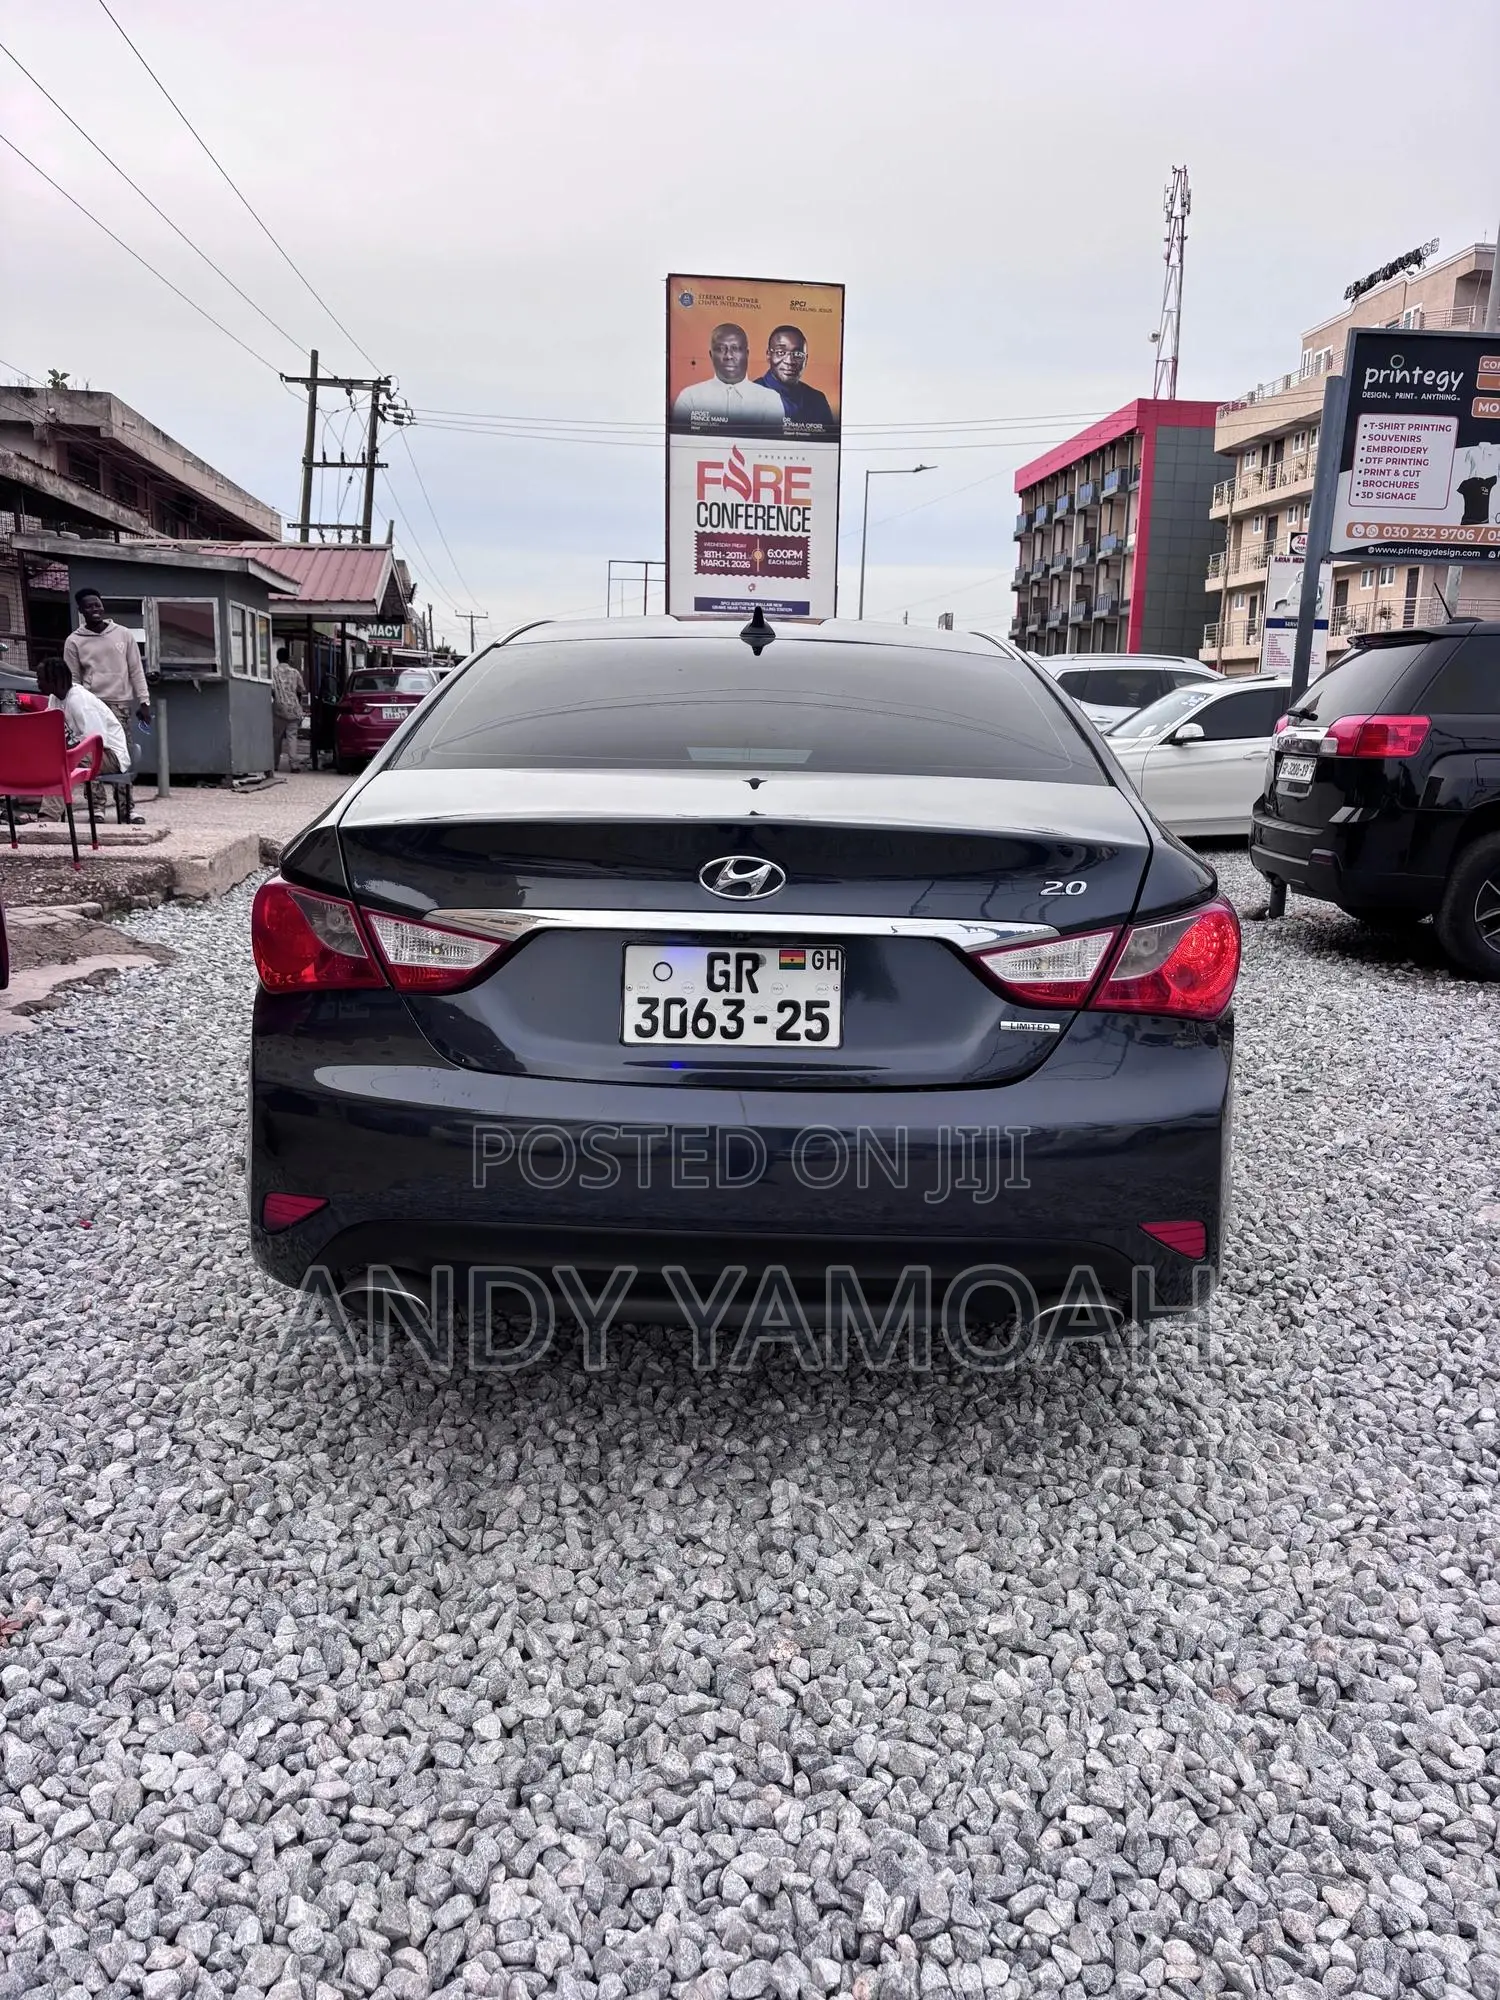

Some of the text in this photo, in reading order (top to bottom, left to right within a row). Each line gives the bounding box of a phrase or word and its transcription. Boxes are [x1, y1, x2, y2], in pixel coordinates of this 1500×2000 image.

[1364, 354, 1464, 392] printegy
[1408, 424, 1452, 432] PRINTING
[1368, 434, 1422, 442] SOUVENIRS
[1366, 445, 1428, 454] EMBROIDERY
[1386, 458, 1429, 466] PRINTING
[1364, 468, 1392, 476] PRINT
[1362, 480, 1419, 489] BROCHURES
[1376, 492, 1416, 500] SIGNAGE
[696, 502, 812, 532] CONFERENCE
[1383, 526, 1409, 538] 030
[1412, 528, 1436, 539] 232
[1440, 528, 1475, 540] 9706
[767, 549, 802, 559] 6:00PM
[1374, 546, 1480, 557] www.printegydesign.com
[731, 560, 750, 569] 2026
[368, 624, 400, 637] MACY
[811, 950, 839, 970] GH
[706, 951, 759, 994] GR
[634, 997, 830, 1042] 3063-25
[1010, 1019, 1050, 1031] LIMITED
